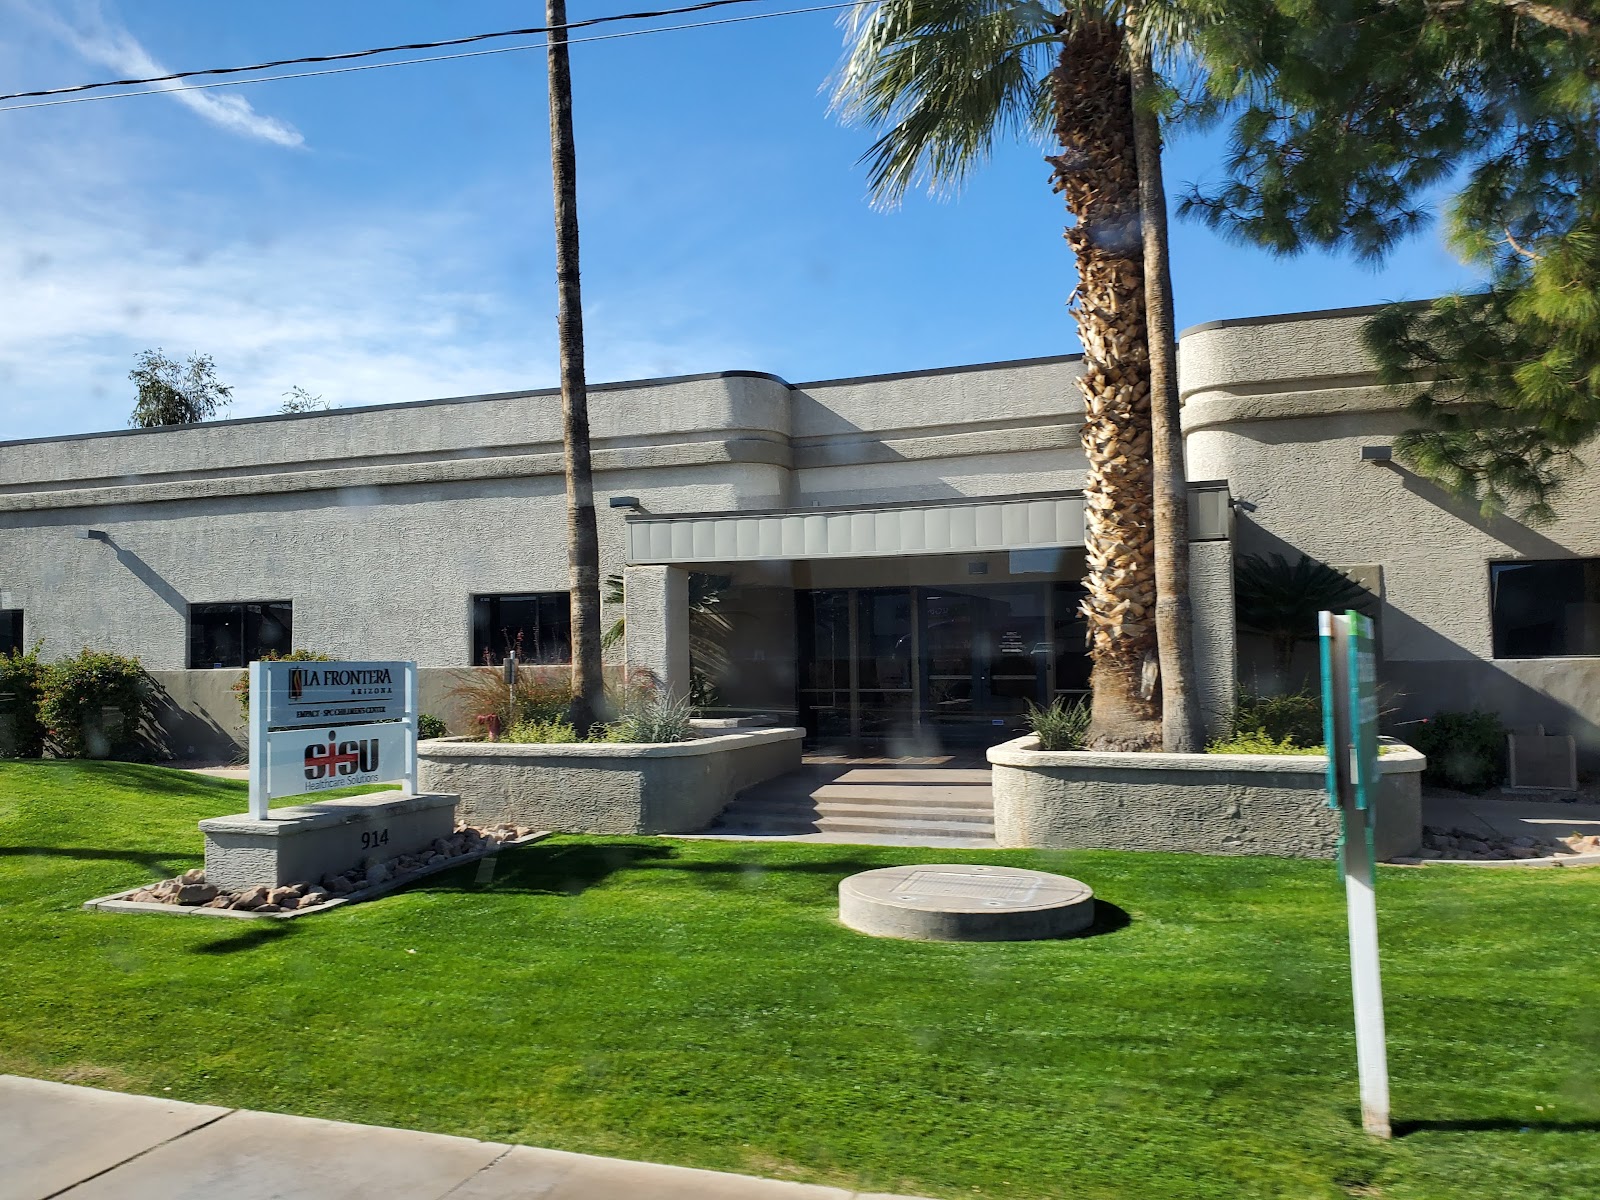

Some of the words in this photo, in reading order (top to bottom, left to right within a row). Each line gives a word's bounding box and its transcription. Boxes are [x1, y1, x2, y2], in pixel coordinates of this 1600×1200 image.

[303, 669, 320, 687] LA
[323, 667, 393, 686] FRONTERA
[351, 687, 393, 695] ARIZONA
[305, 778, 346, 791] Healthcare
[347, 774, 379, 786] Solutions
[361, 828, 389, 850] 914
